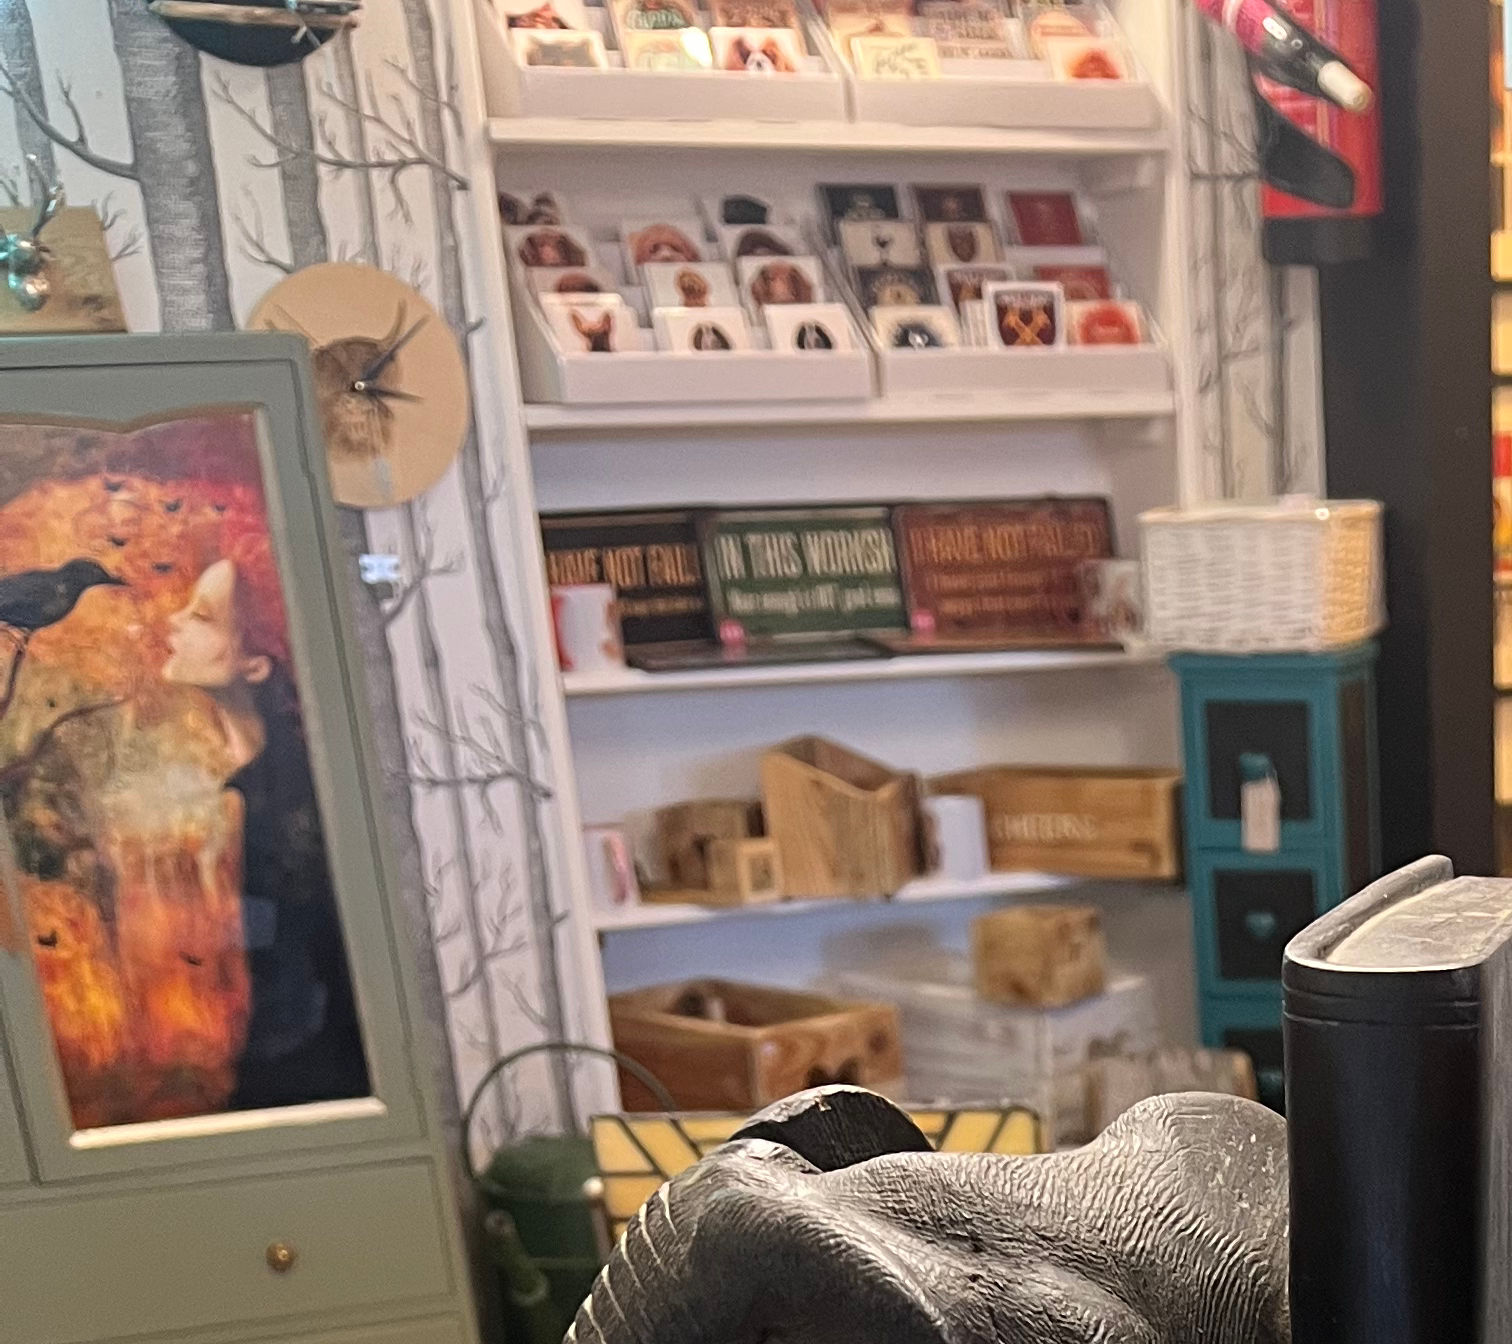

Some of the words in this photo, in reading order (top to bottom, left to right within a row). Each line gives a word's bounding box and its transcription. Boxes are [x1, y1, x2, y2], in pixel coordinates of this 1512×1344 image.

[647, 542, 699, 587] FAIL
[714, 533, 746, 580] IN
[744, 530, 802, 579] THIS
